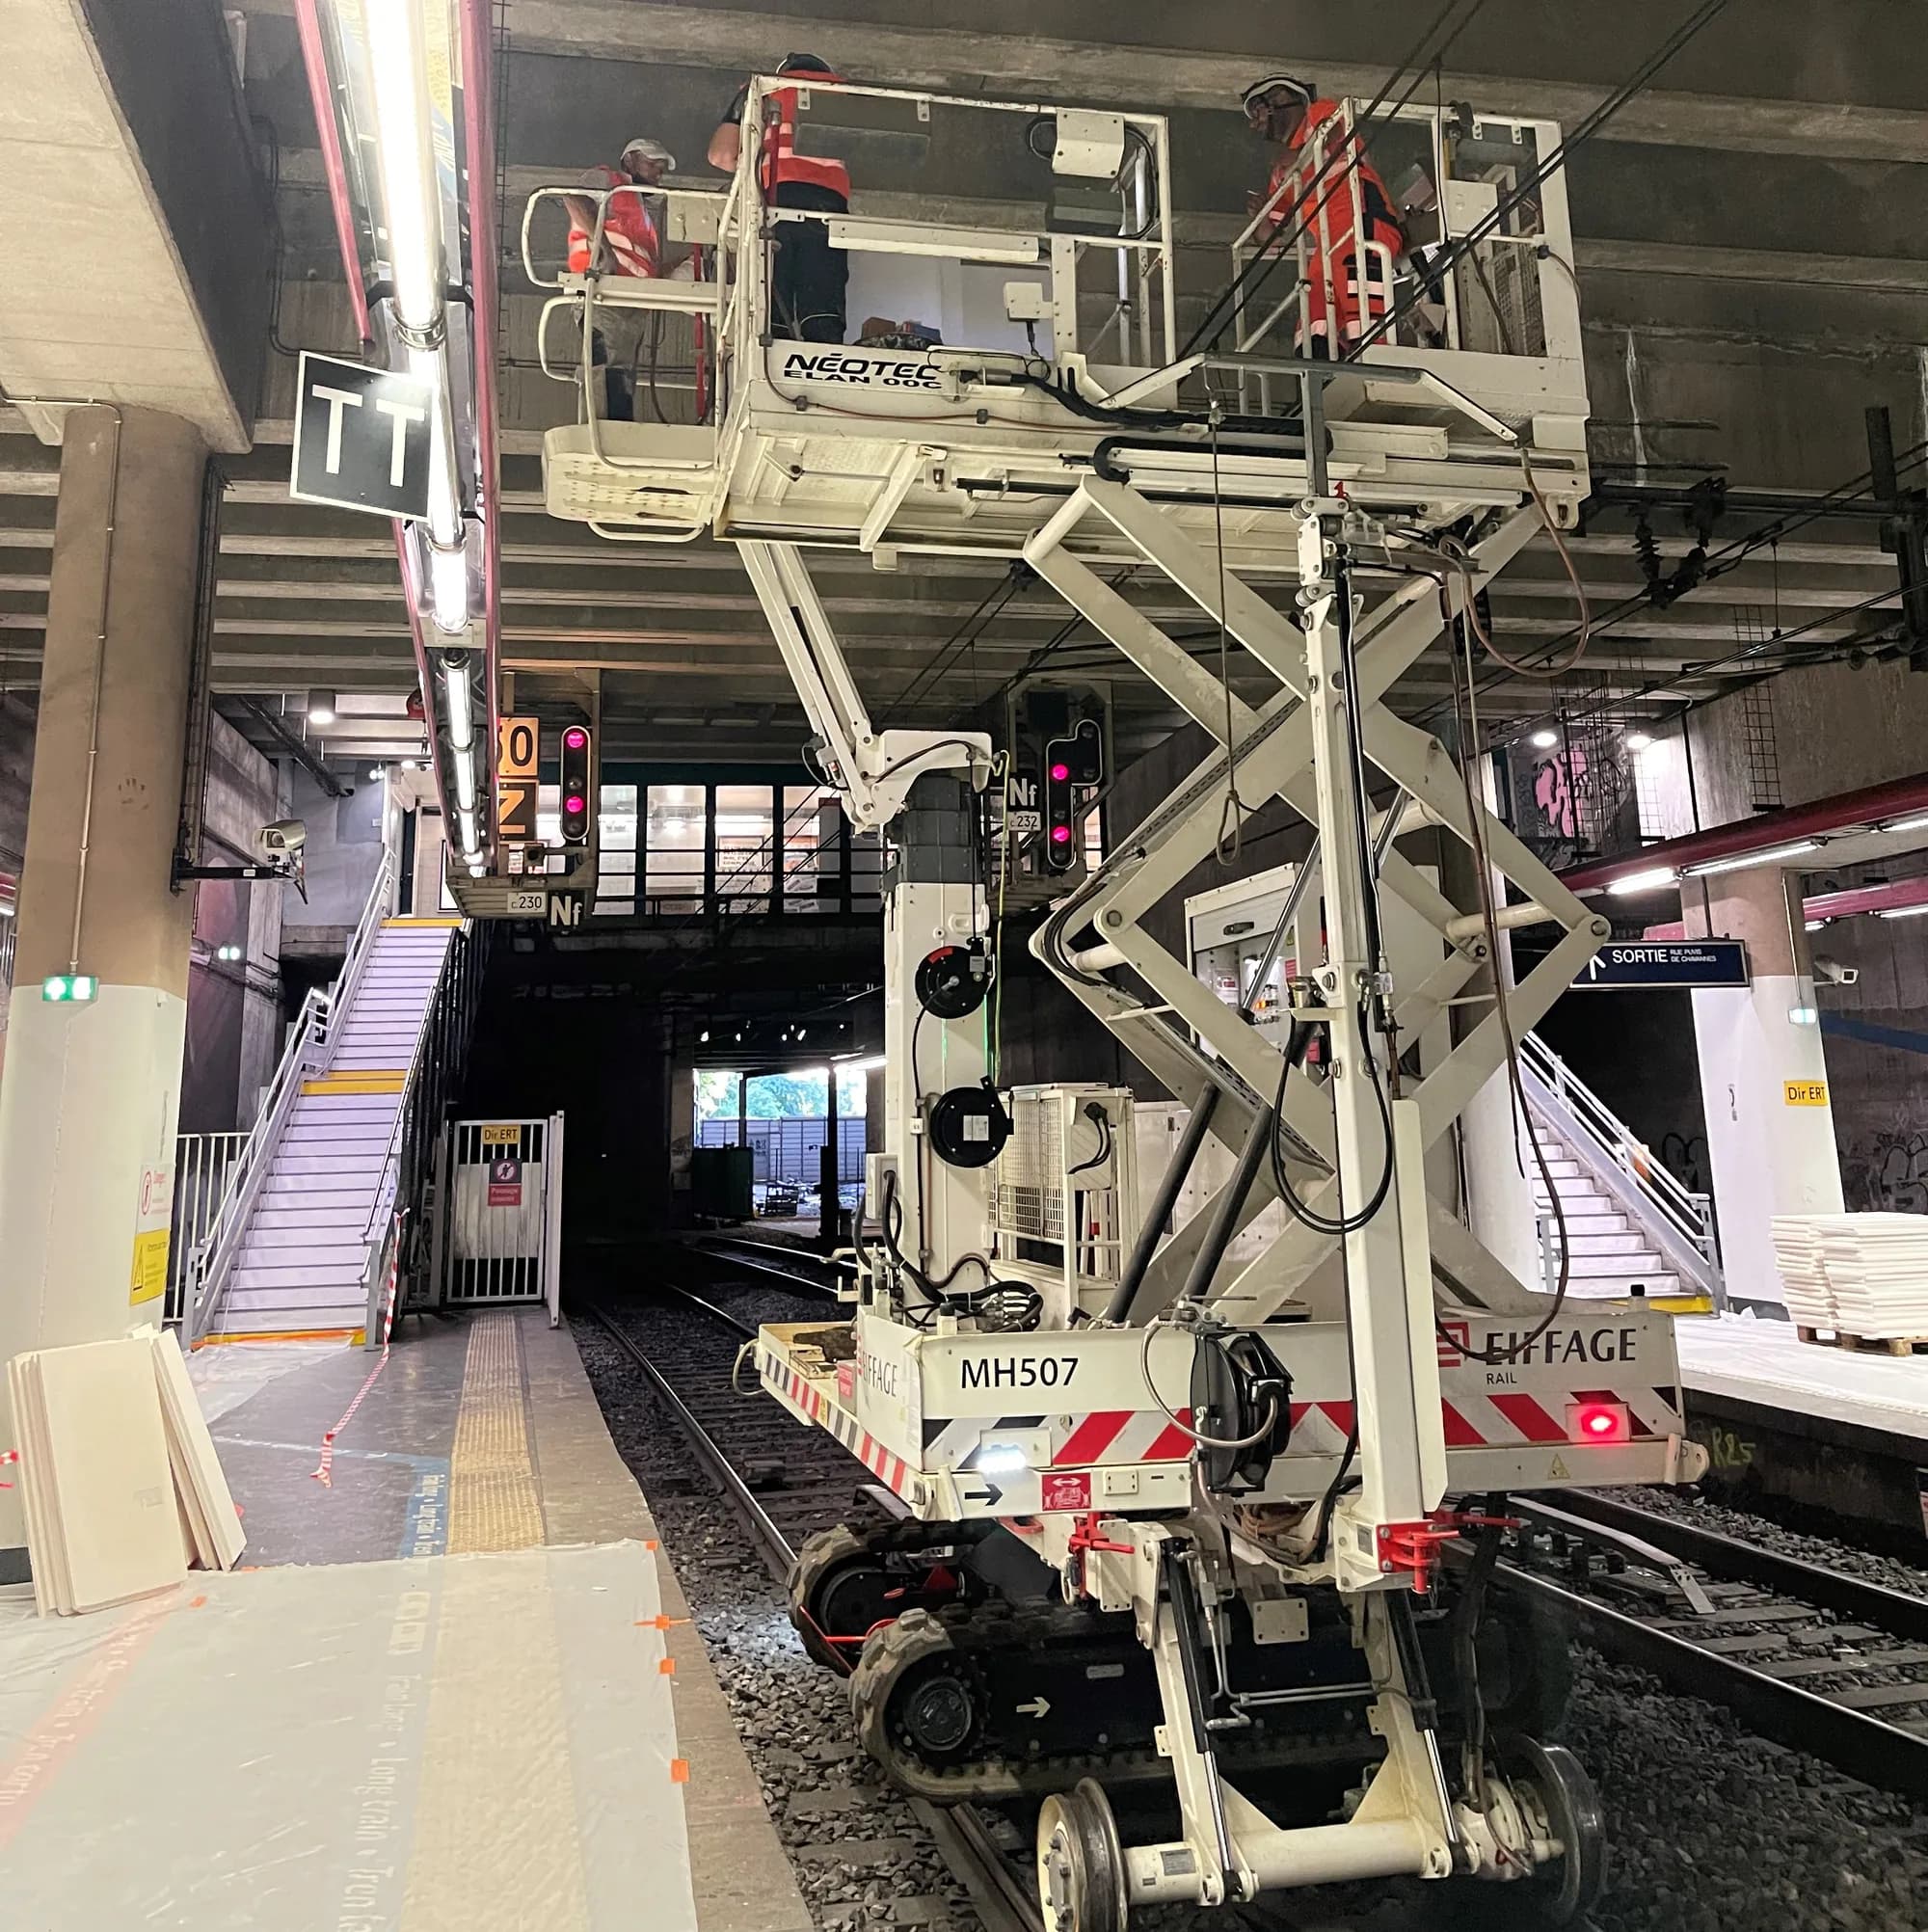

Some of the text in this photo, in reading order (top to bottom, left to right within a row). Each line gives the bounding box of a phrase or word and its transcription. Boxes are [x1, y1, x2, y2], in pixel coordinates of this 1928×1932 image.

[783, 369, 870, 385] ELAN
[785, 353, 942, 381] NÉOTEC
[311, 384, 425, 487] TT
[1009, 777, 1038, 806] Nf
[550, 895, 583, 926] Nf
[1612, 949, 1669, 964] SORTIE
[1787, 1087, 1825, 1100] Dir ERT
[484, 1128, 518, 1140] Dir ERT
[1486, 1328, 1637, 1365] EIFFAGE
[961, 1356, 1079, 1388] MH507
[1486, 1372, 1517, 1385] RAIL
[354, 1758, 410, 1842] Long train
[340, 1865, 396, 1908] Tren
